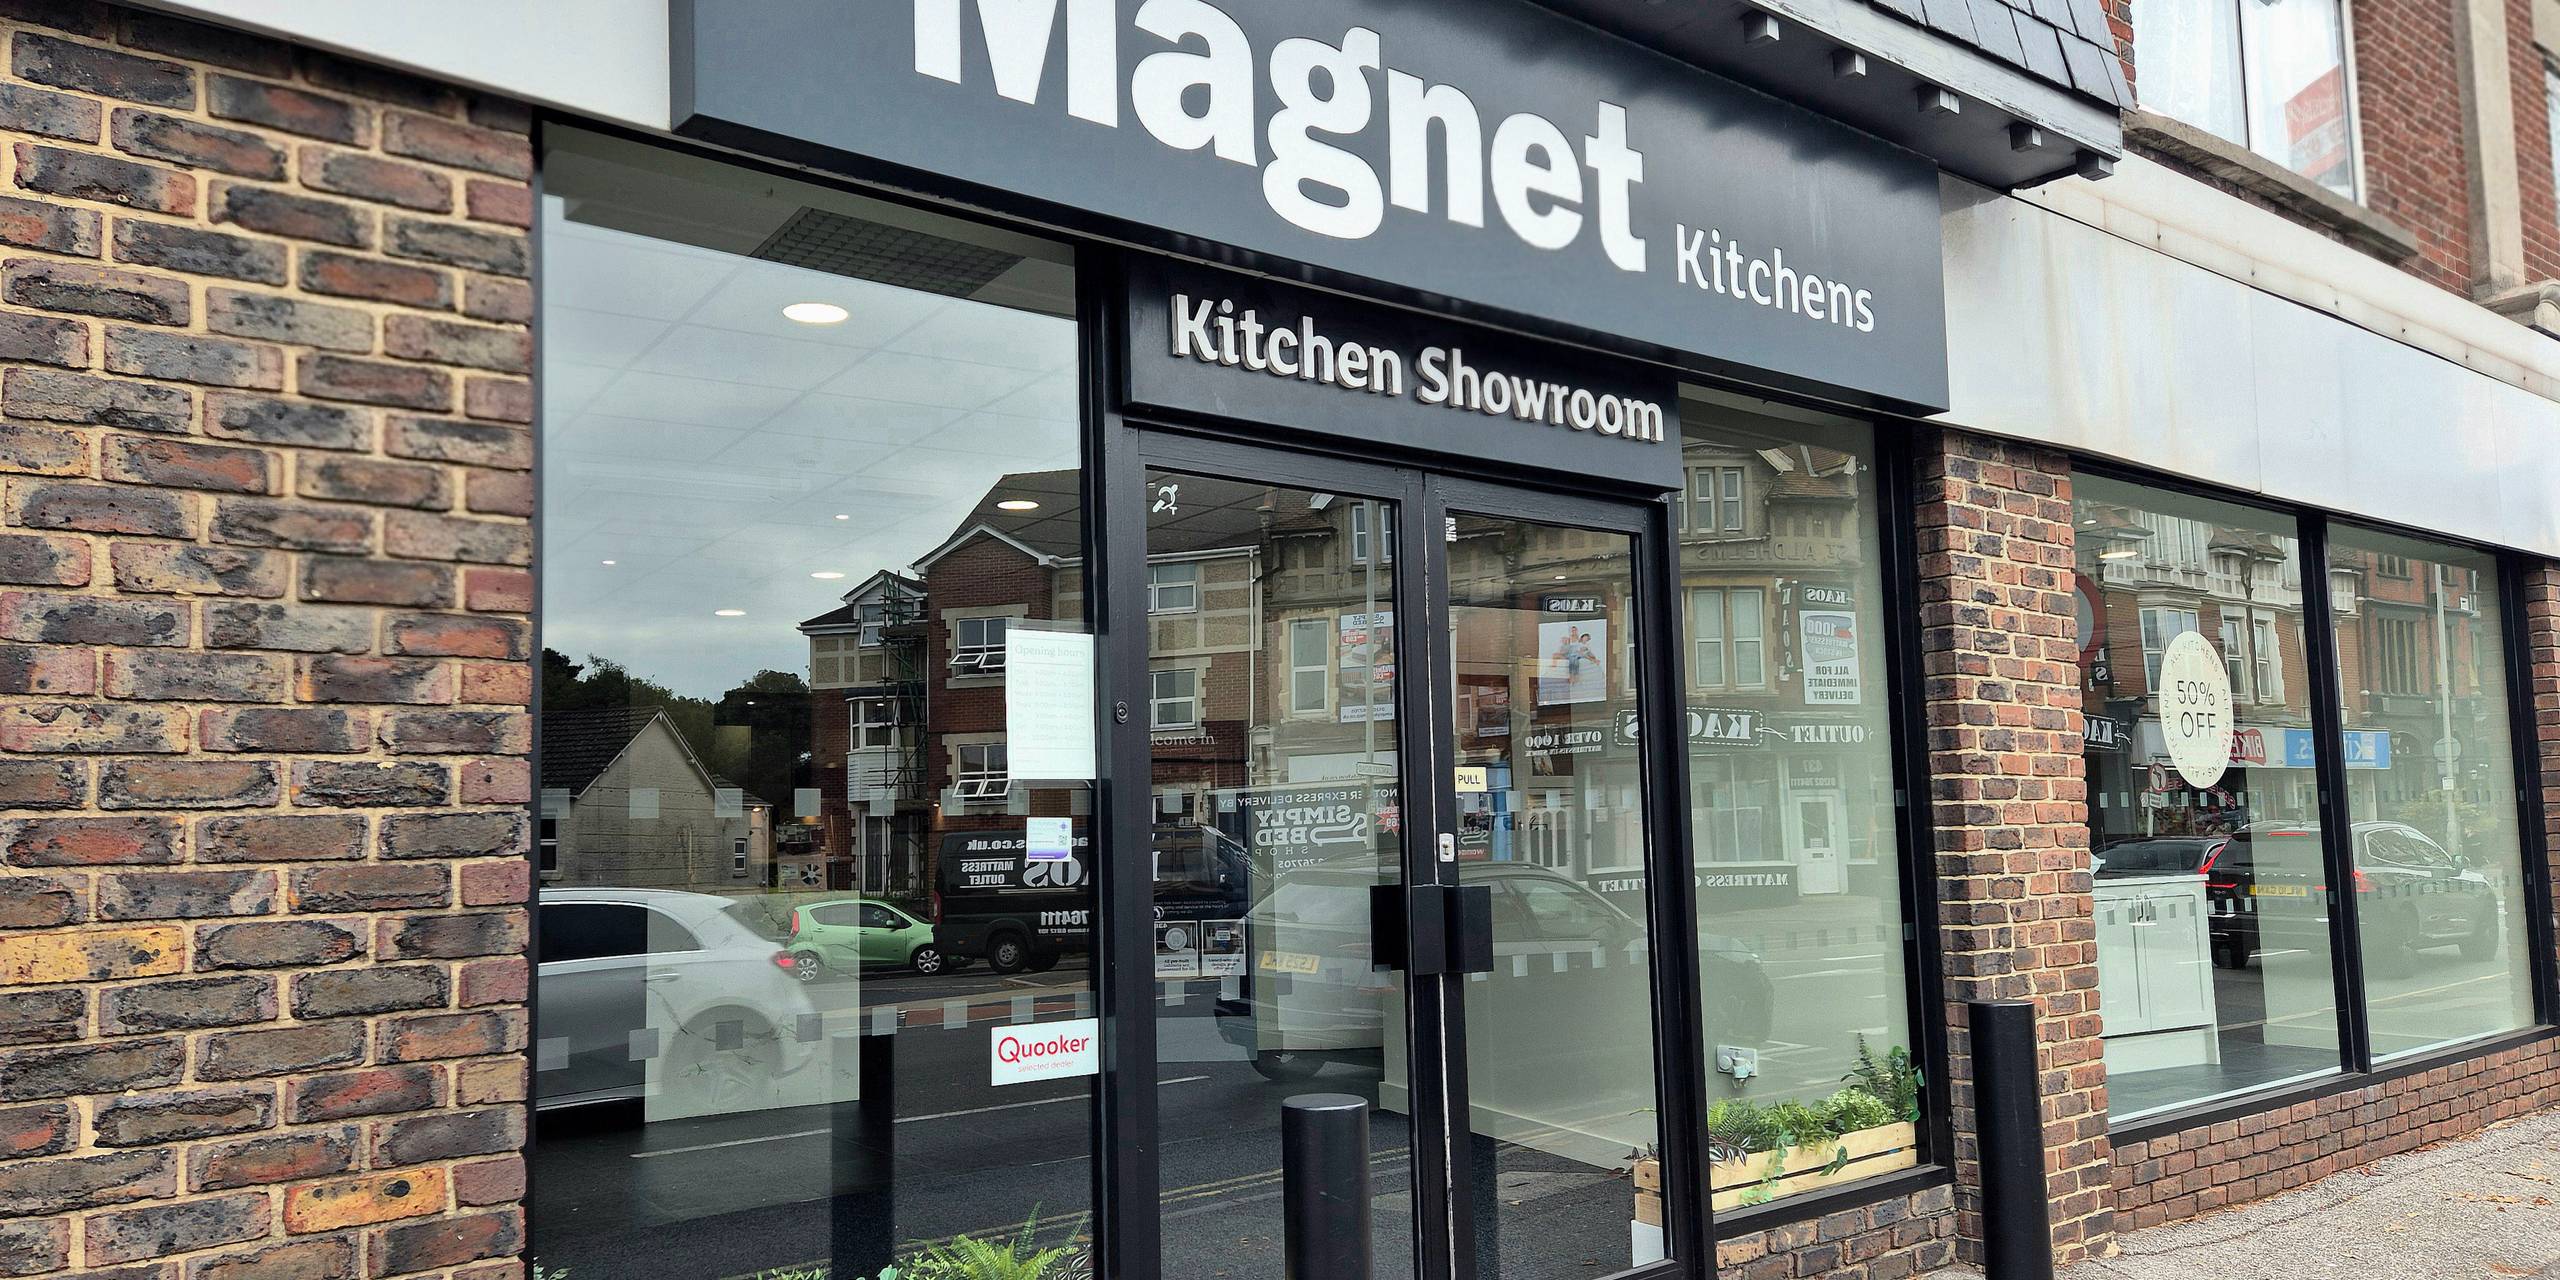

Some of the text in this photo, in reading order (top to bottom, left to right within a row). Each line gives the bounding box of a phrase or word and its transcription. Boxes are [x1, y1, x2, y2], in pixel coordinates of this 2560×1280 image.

[1676, 223, 1877, 334] Kitchens
[1170, 294, 1666, 443] Kitchen Showroom
[1015, 644, 1056, 659] Opening
[2177, 680, 2215, 706] 50%
[2180, 711, 2216, 739] OFF
[1458, 774, 1481, 785] PULL
[997, 1034, 1090, 1064] Quooker
[1017, 1061, 1050, 1073] selected
